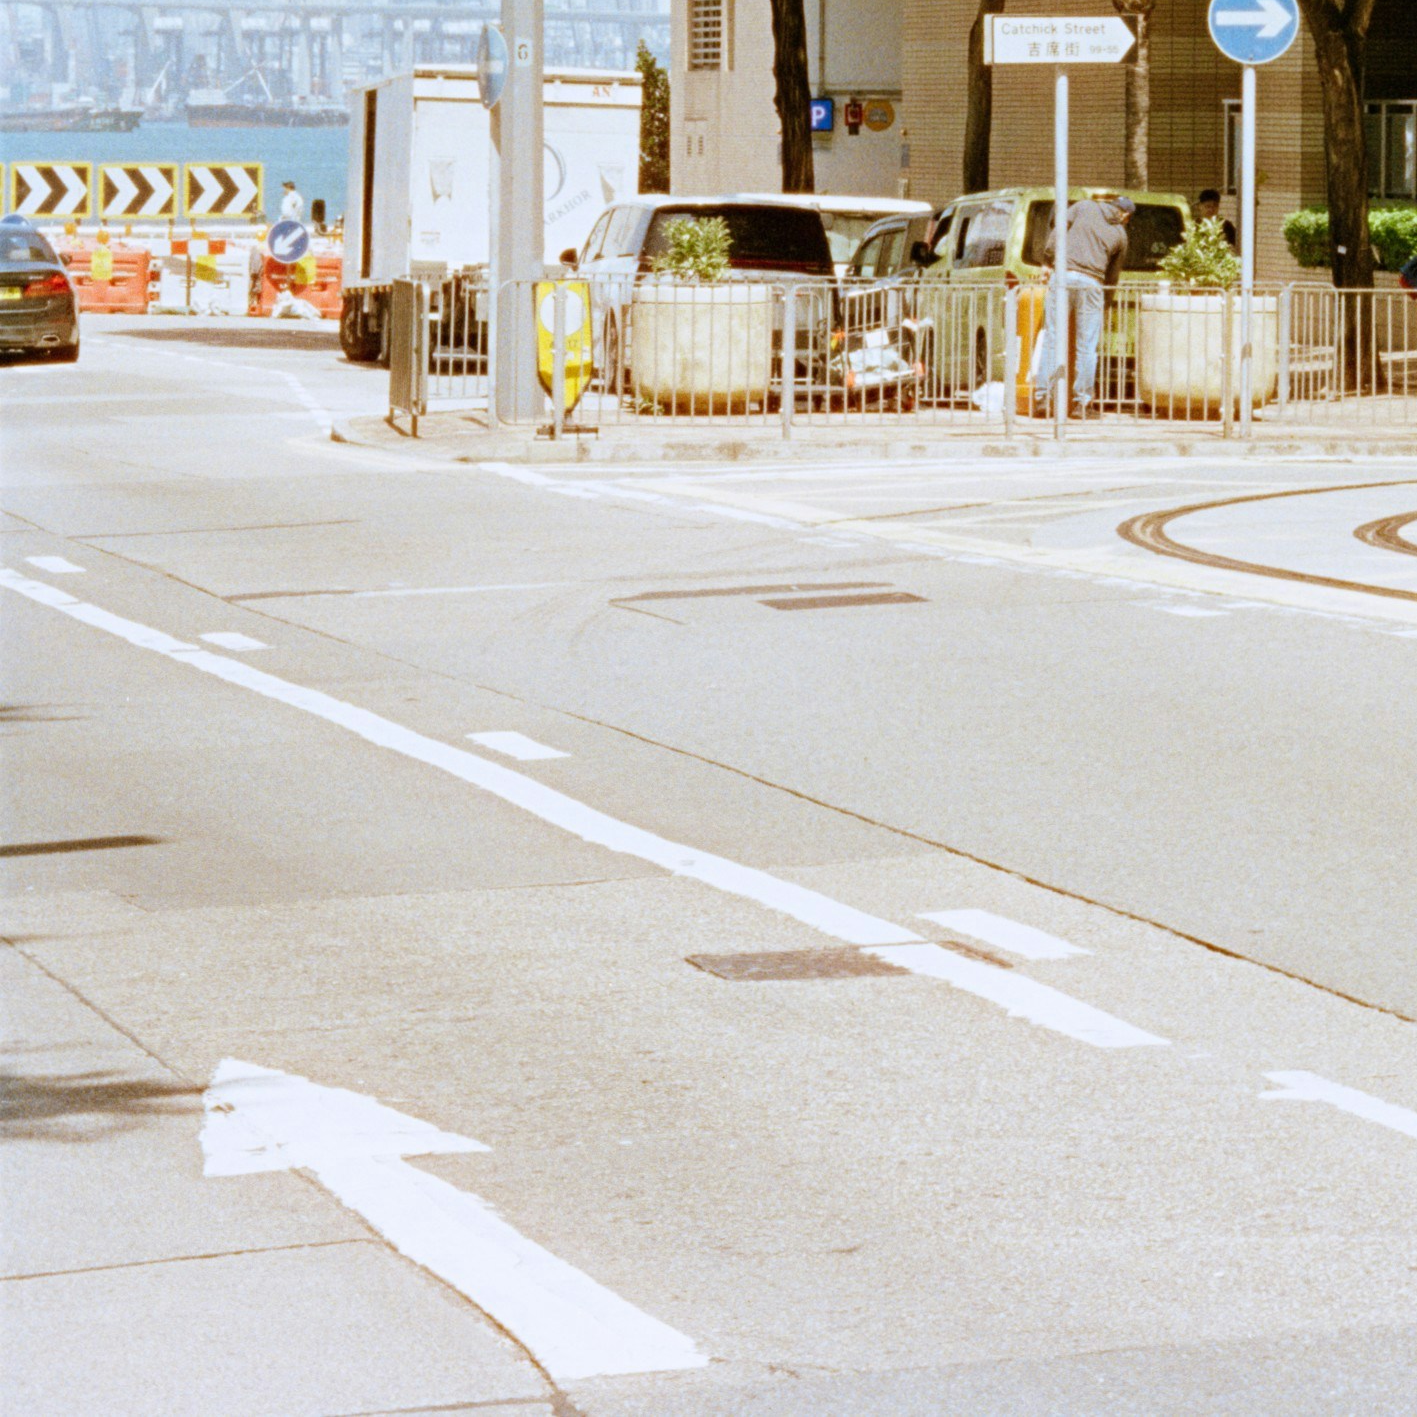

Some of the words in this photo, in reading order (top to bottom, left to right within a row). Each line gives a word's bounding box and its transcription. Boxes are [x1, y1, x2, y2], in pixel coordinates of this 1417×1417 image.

[1001, 22, 1057, 35] Catchick
[1064, 22, 1106, 35] Street
[517, 43, 528, 61] 6
[1028, 42, 1080, 57] 吉席街
[811, 105, 826, 128] P
